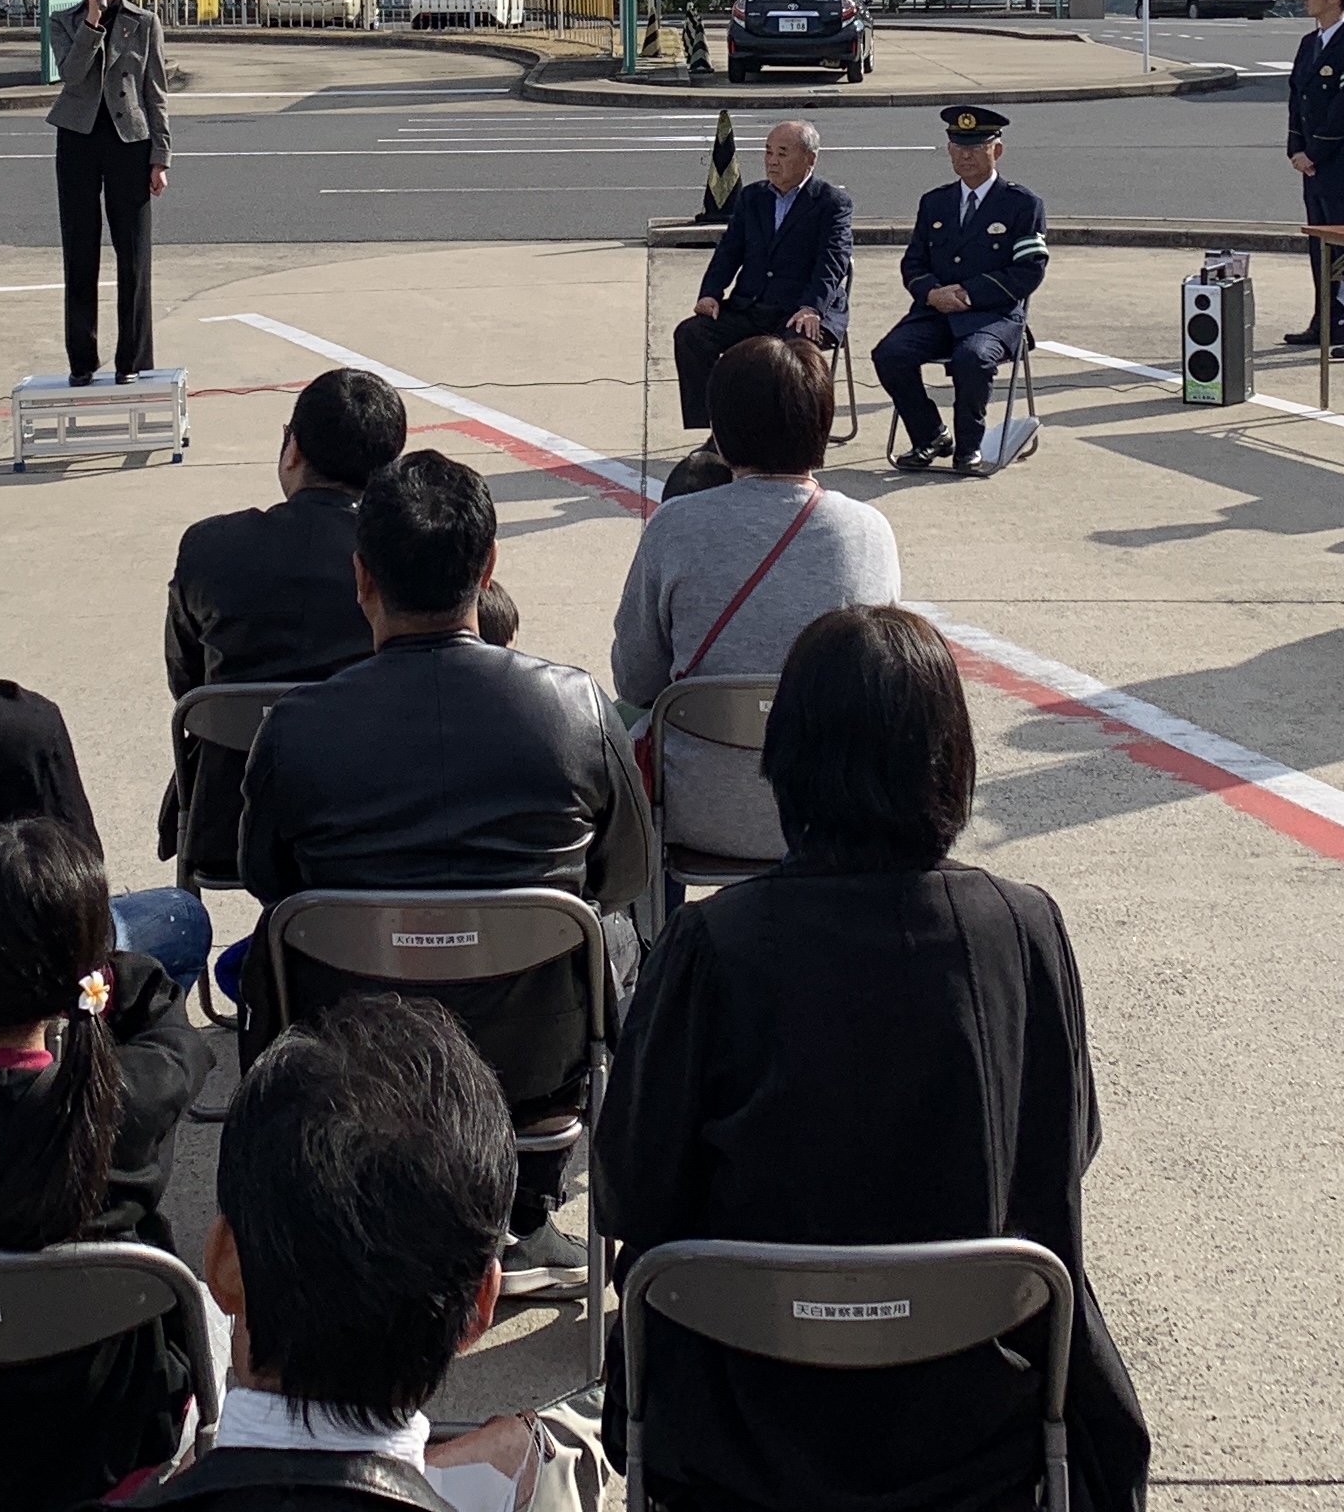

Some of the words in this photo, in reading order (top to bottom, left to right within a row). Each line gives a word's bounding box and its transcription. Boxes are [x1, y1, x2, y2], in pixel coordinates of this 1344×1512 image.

[796, 1302, 907, 1319] 天白警察署講堂用
